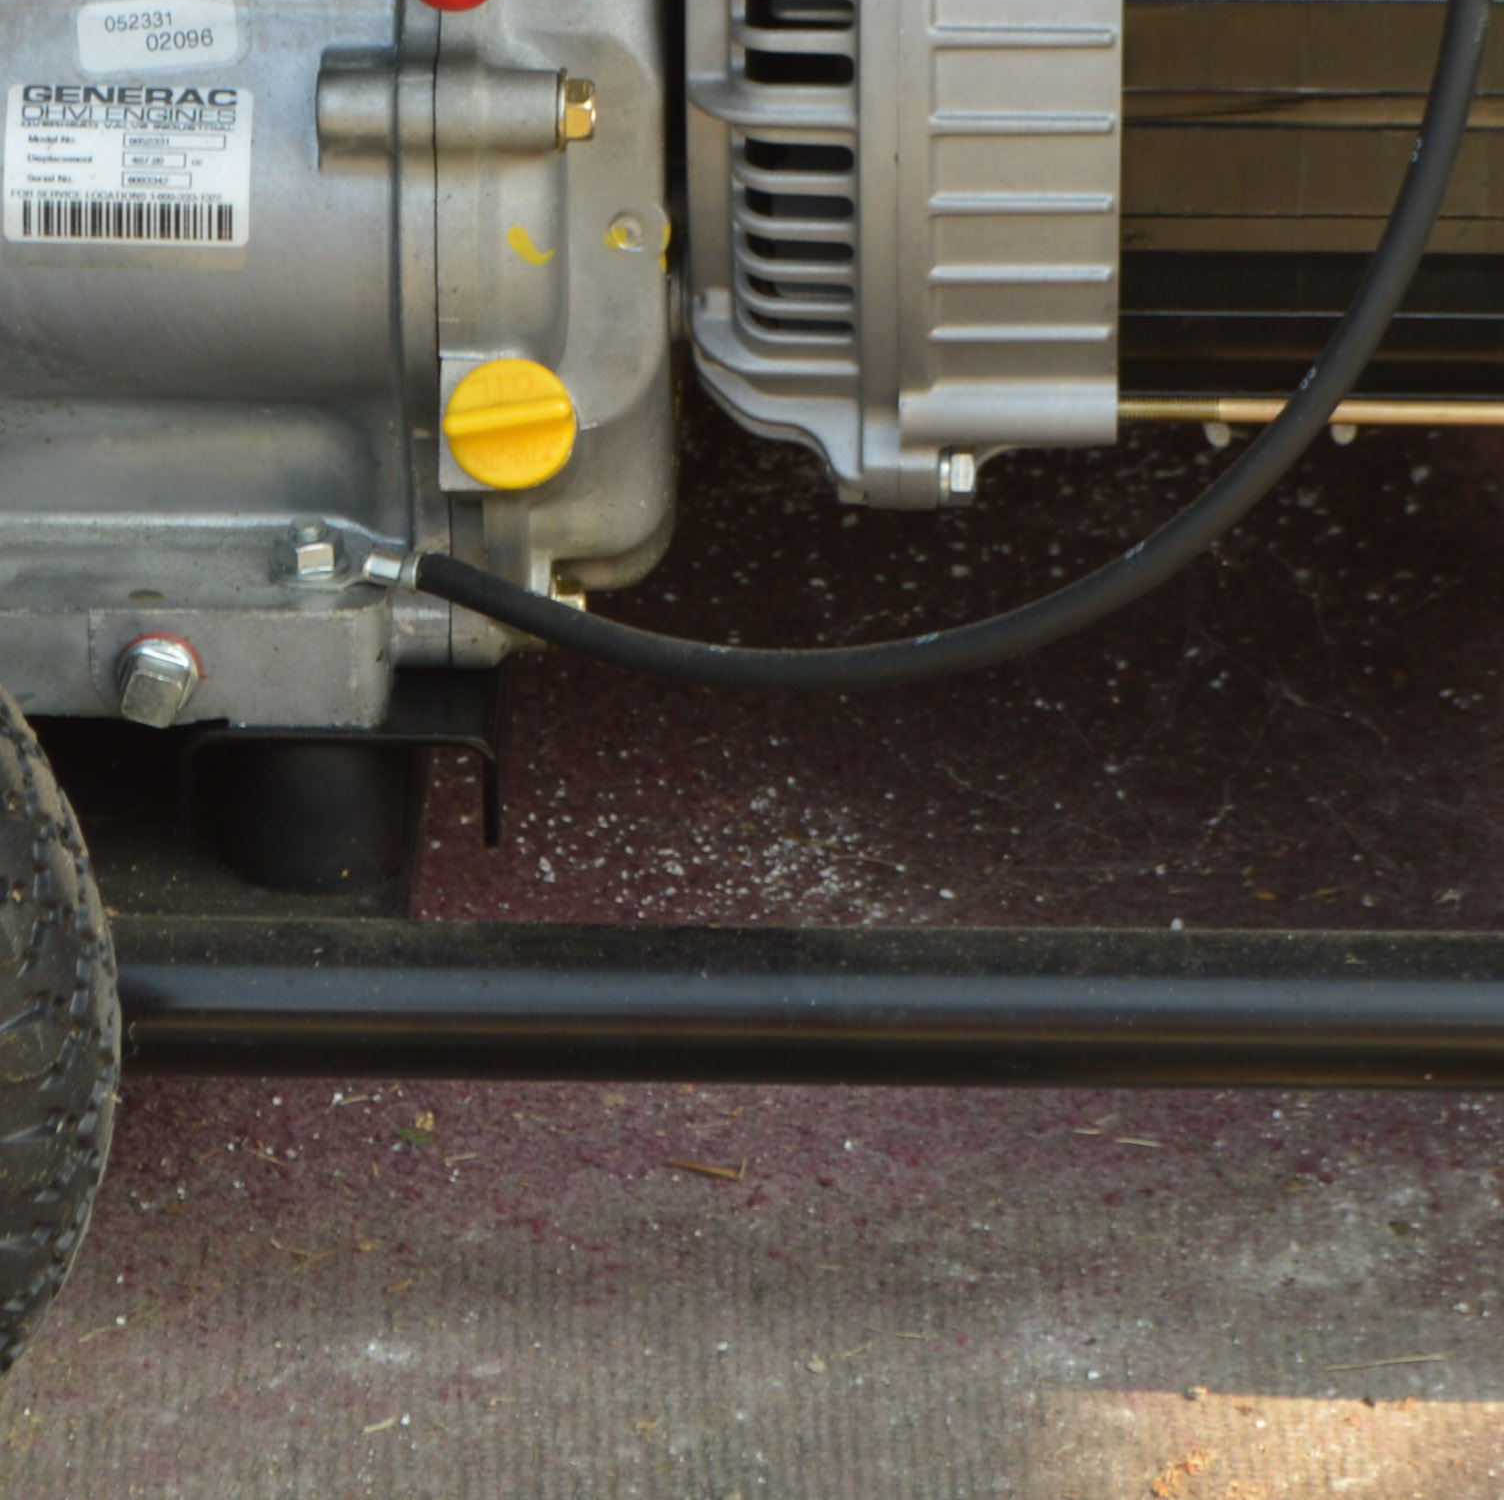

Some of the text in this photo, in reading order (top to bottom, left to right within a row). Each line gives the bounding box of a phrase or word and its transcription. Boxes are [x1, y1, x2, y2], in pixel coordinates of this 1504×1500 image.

[104, 11, 172, 33] 052331
[146, 27, 214, 52] 02096
[23, 86, 237, 106] GENERAC
[21, 105, 236, 124] OHVI ENGINES
